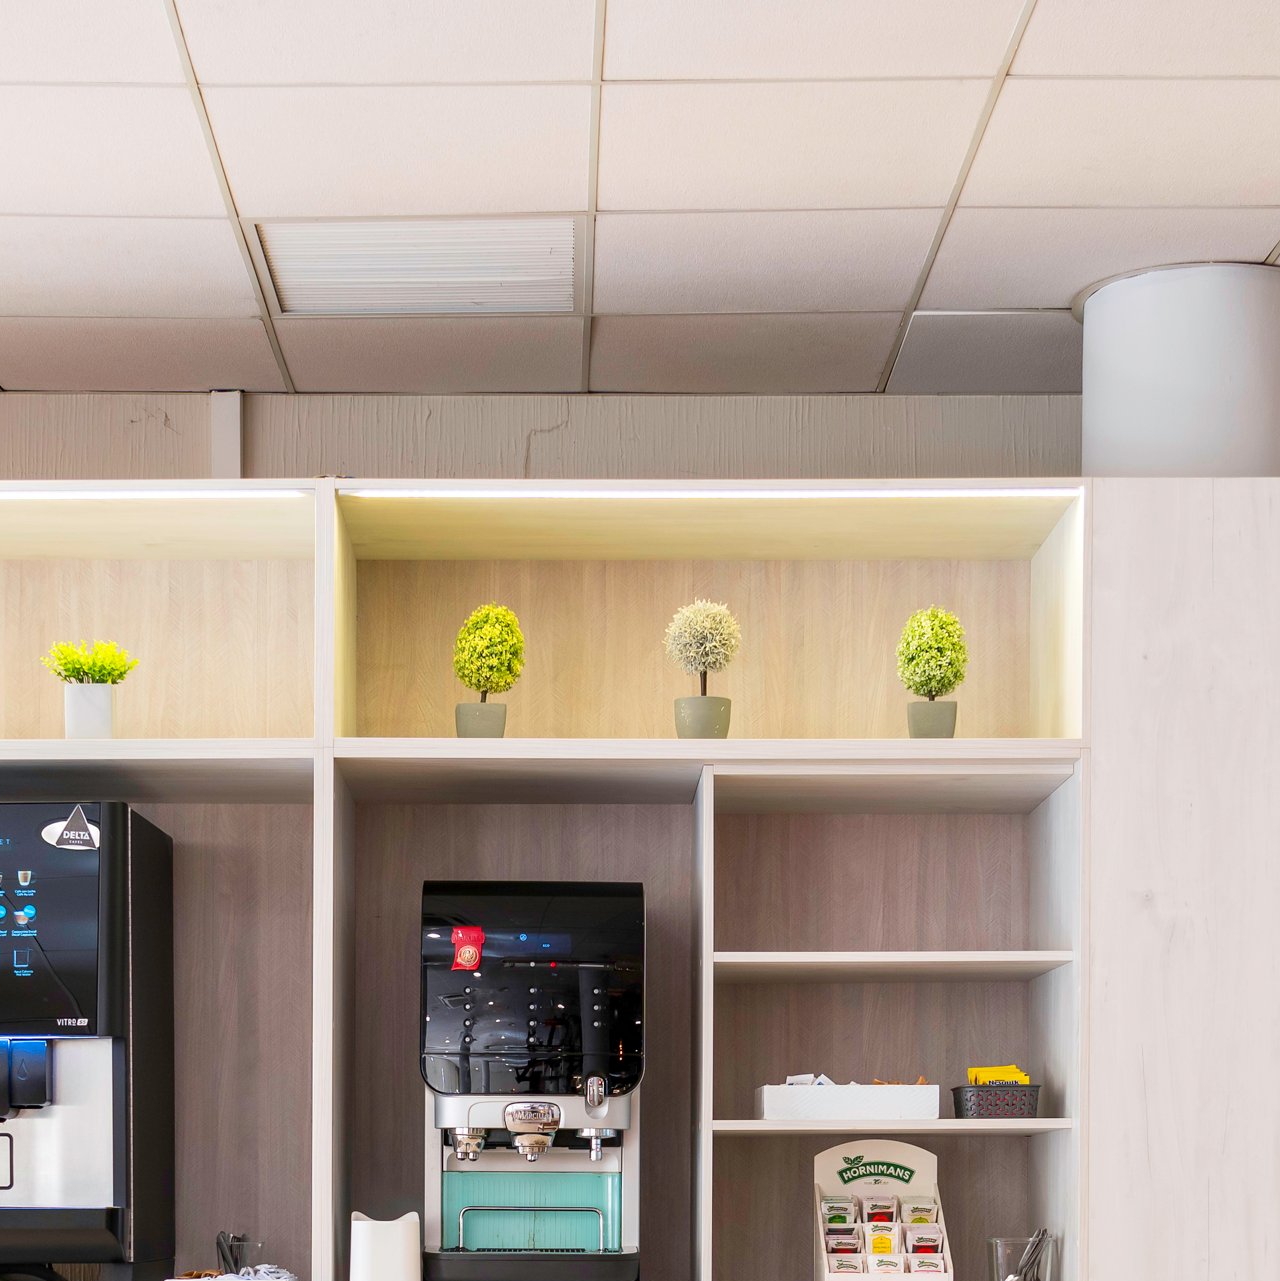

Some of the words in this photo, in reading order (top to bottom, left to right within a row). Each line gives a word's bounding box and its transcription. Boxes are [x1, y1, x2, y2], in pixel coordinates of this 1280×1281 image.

[62, 830, 90, 840] DELTA
[56, 1018, 76, 1027] VITRO
[842, 1164, 911, 1181] HORNIMANS
